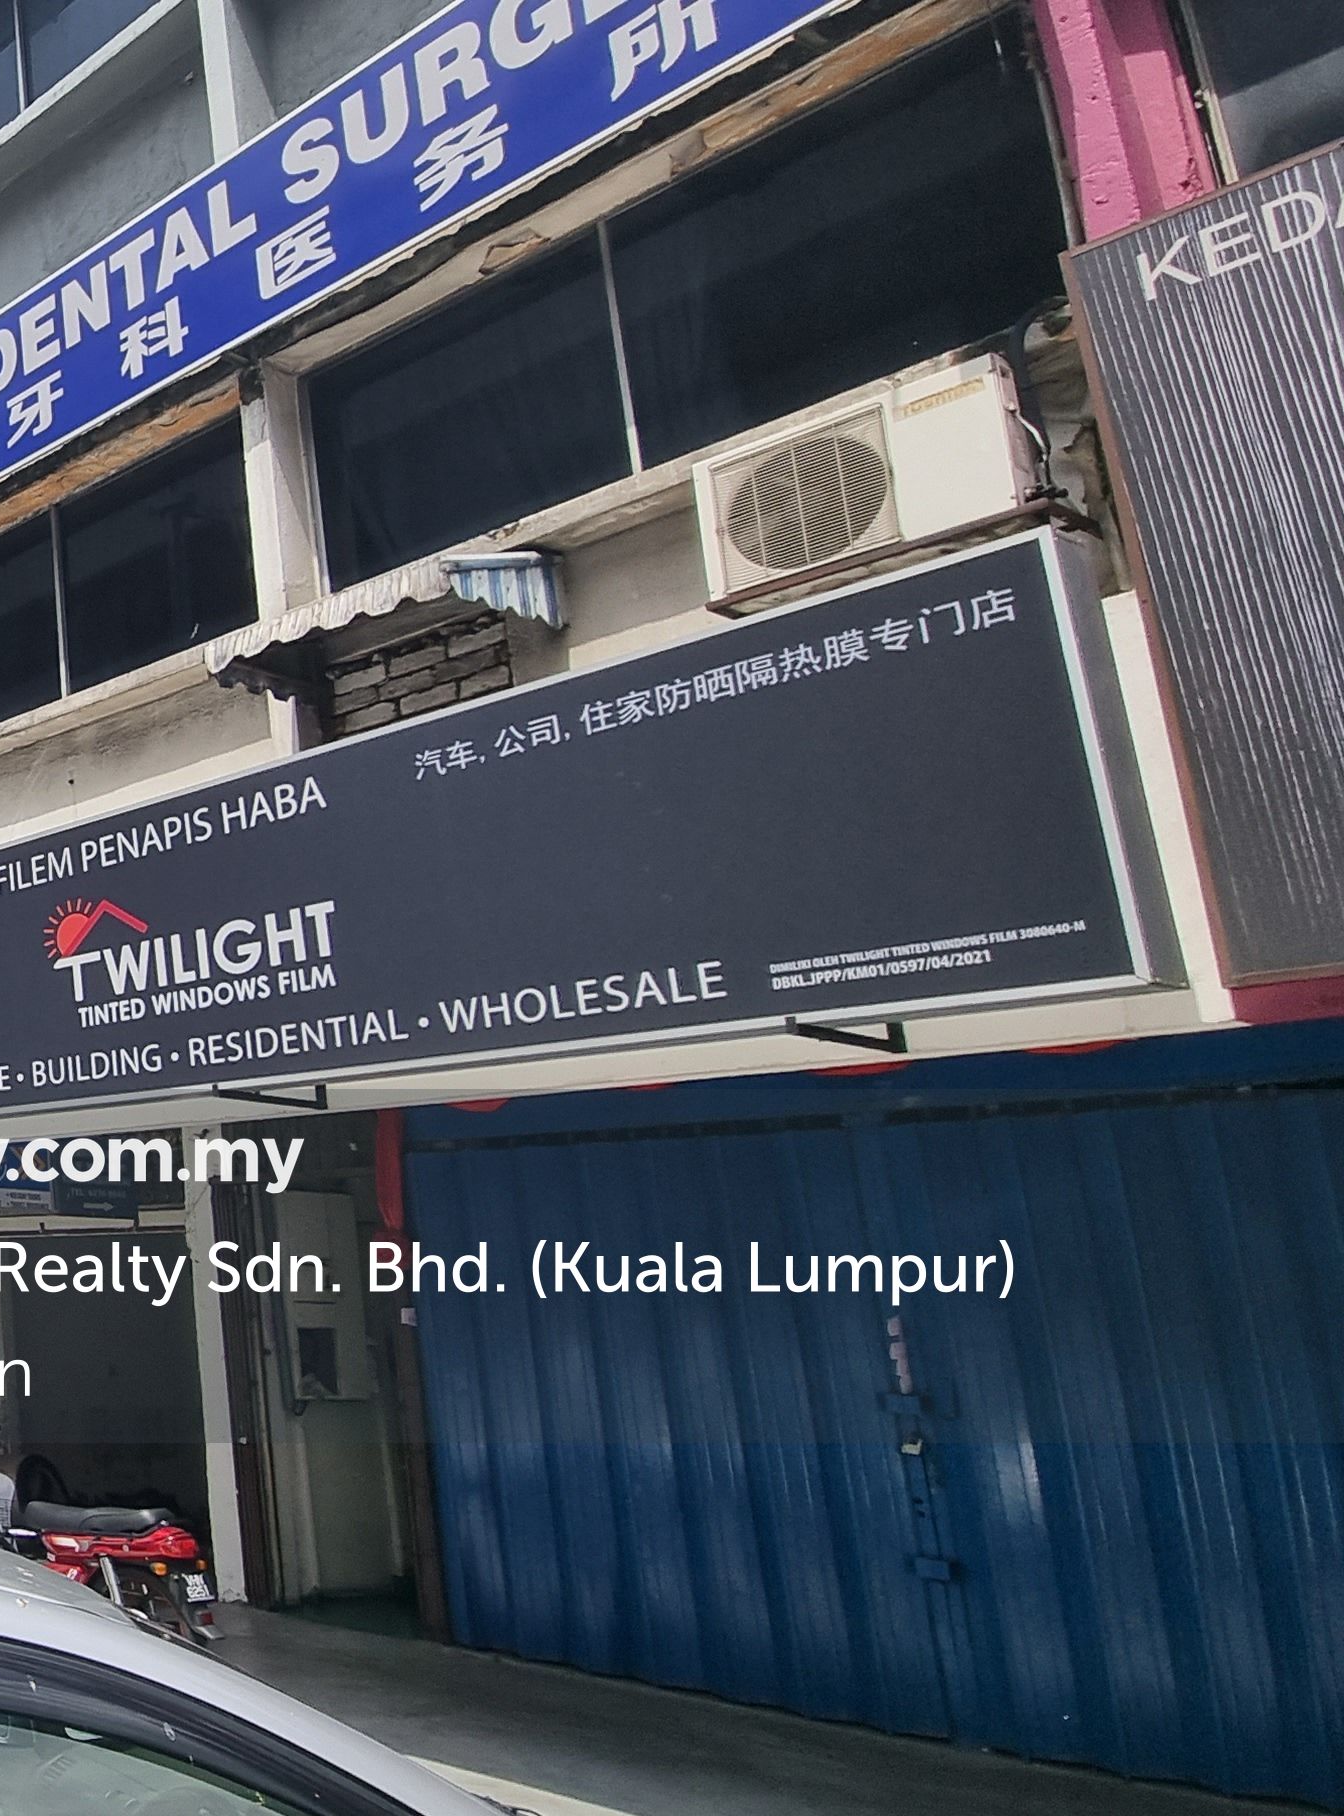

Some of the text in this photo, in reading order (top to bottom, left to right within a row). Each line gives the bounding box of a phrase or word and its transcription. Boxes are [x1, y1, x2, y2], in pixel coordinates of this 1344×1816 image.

[281, 0, 618, 203] SURG
[1136, 189, 1344, 301] KED
[578, 586, 1018, 738] 住家防晒隔热膜专门店
[81, 805, 213, 870] PENAPIS
[222, 776, 328, 835] HABA
[53, 901, 337, 1002] TWILIGHT
[78, 963, 337, 1028] TINTED WINDOWS FILM
[839, 948, 891, 966] TWILIGHT
[891, 942, 930, 957] TINTED
[930, 933, 988, 951] WINDOWS
[988, 930, 1018, 944] FILM
[32, 1043, 163, 1087] BUILDING
[189, 1002, 410, 1067] RESIDENTIAL
[438, 961, 729, 1034] WHOLESALE
